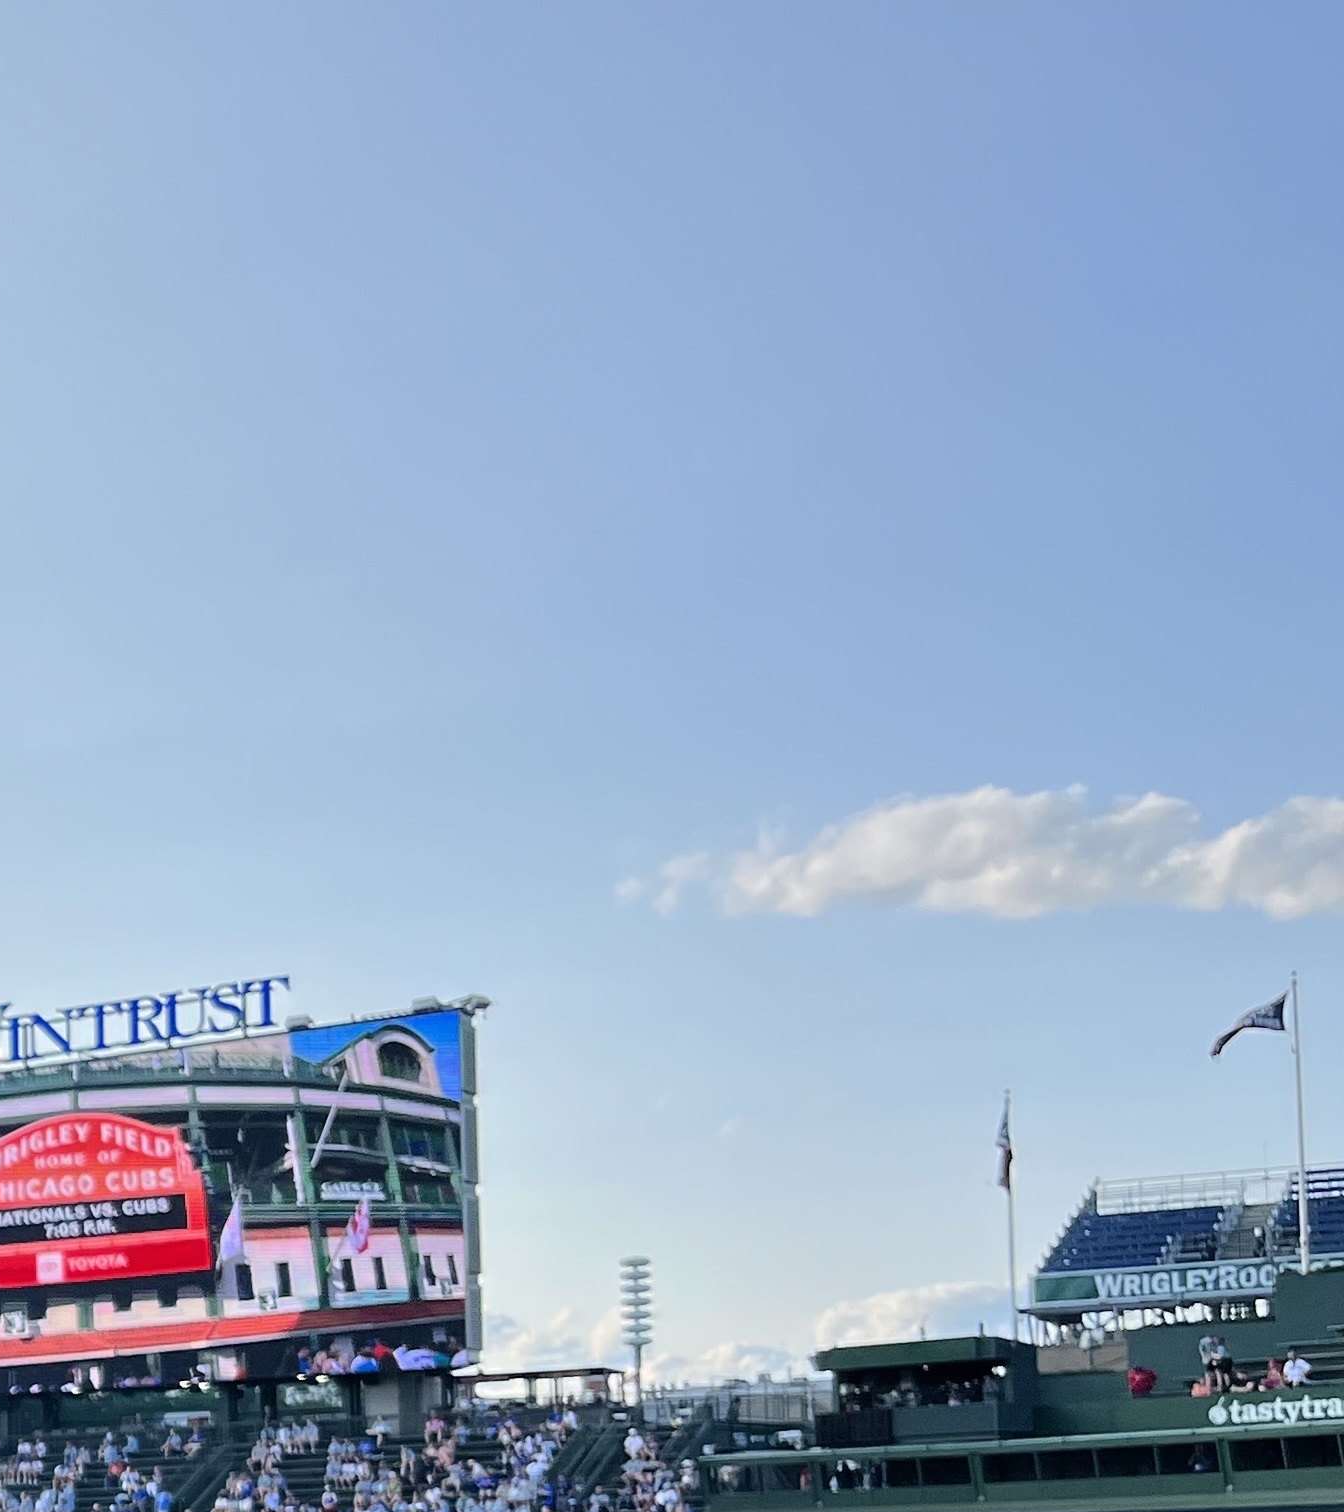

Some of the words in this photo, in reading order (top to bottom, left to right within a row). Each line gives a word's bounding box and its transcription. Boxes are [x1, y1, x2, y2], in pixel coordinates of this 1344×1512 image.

[99, 1122, 173, 1158] FIELD
[34, 1151, 86, 1170] HOME
[97, 1149, 122, 1164] OF
[105, 1166, 175, 1193] CUBS
[89, 1200, 119, 1219] VS.
[121, 1196, 172, 1216] CUBS
[43, 1222, 81, 1240] 7:05
[66, 1252, 129, 1273] TOYOTA
